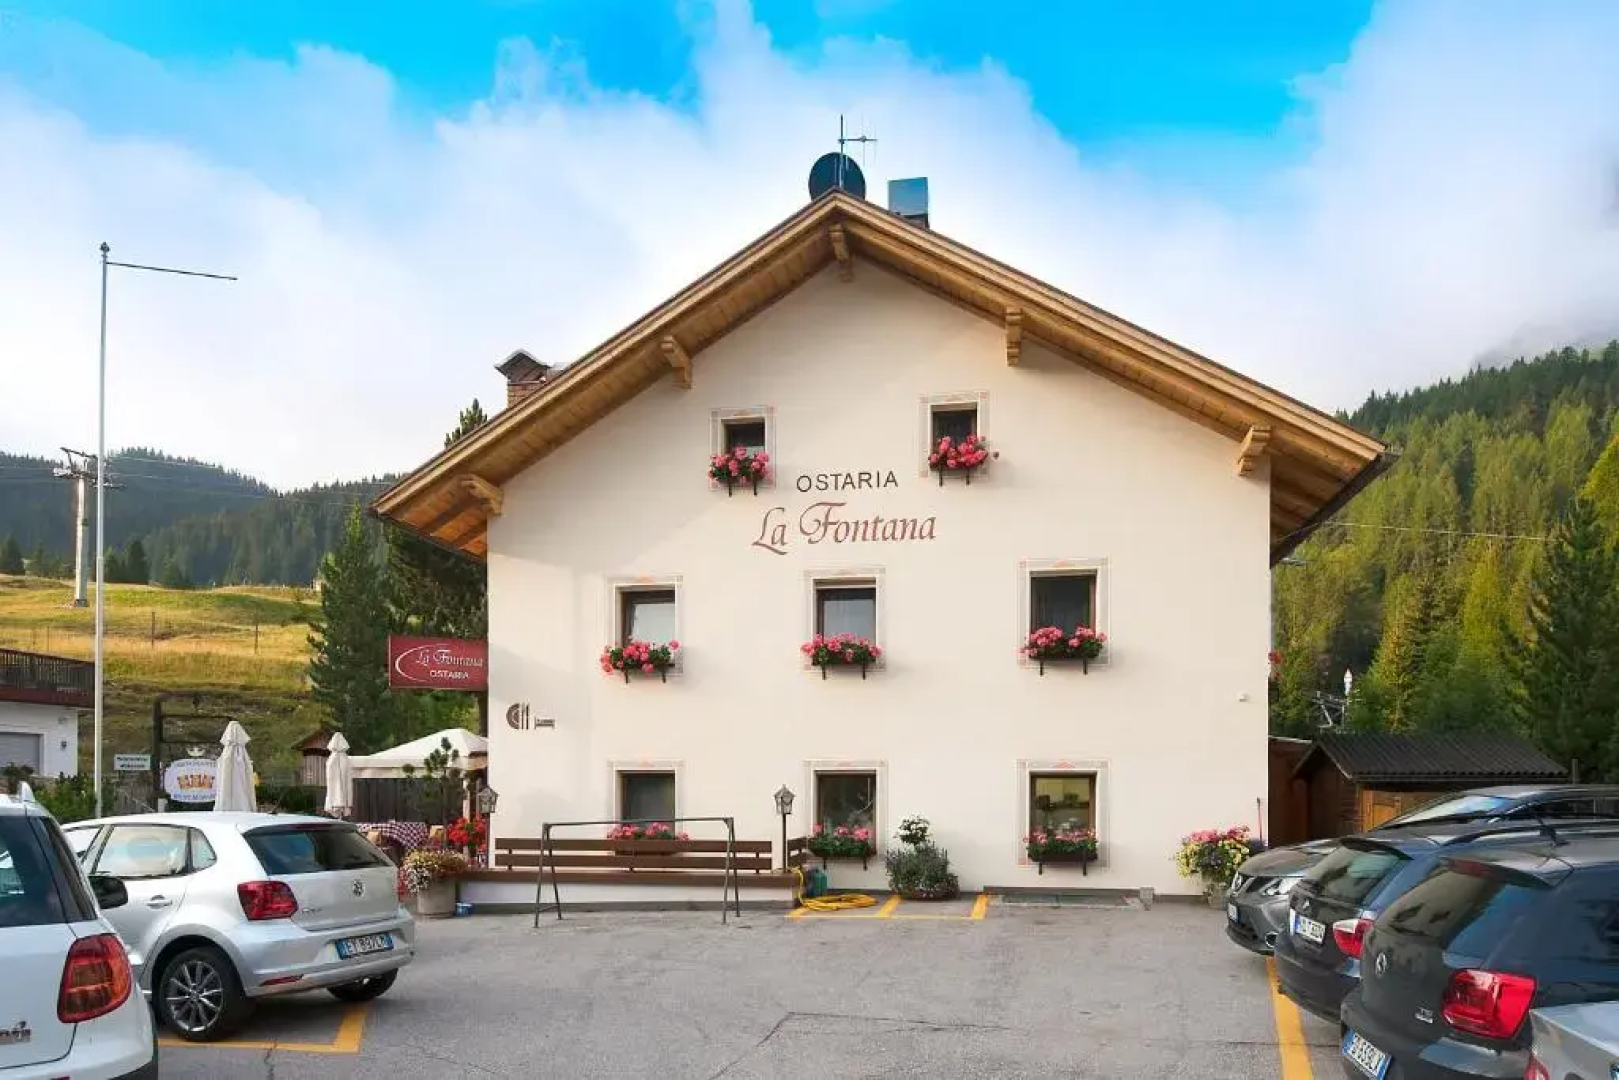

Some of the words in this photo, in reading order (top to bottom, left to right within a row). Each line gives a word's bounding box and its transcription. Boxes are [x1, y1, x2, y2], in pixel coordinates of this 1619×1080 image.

[796, 470, 899, 493] OSTARIA
[752, 506, 788, 556] La
[799, 501, 937, 545] Fontana
